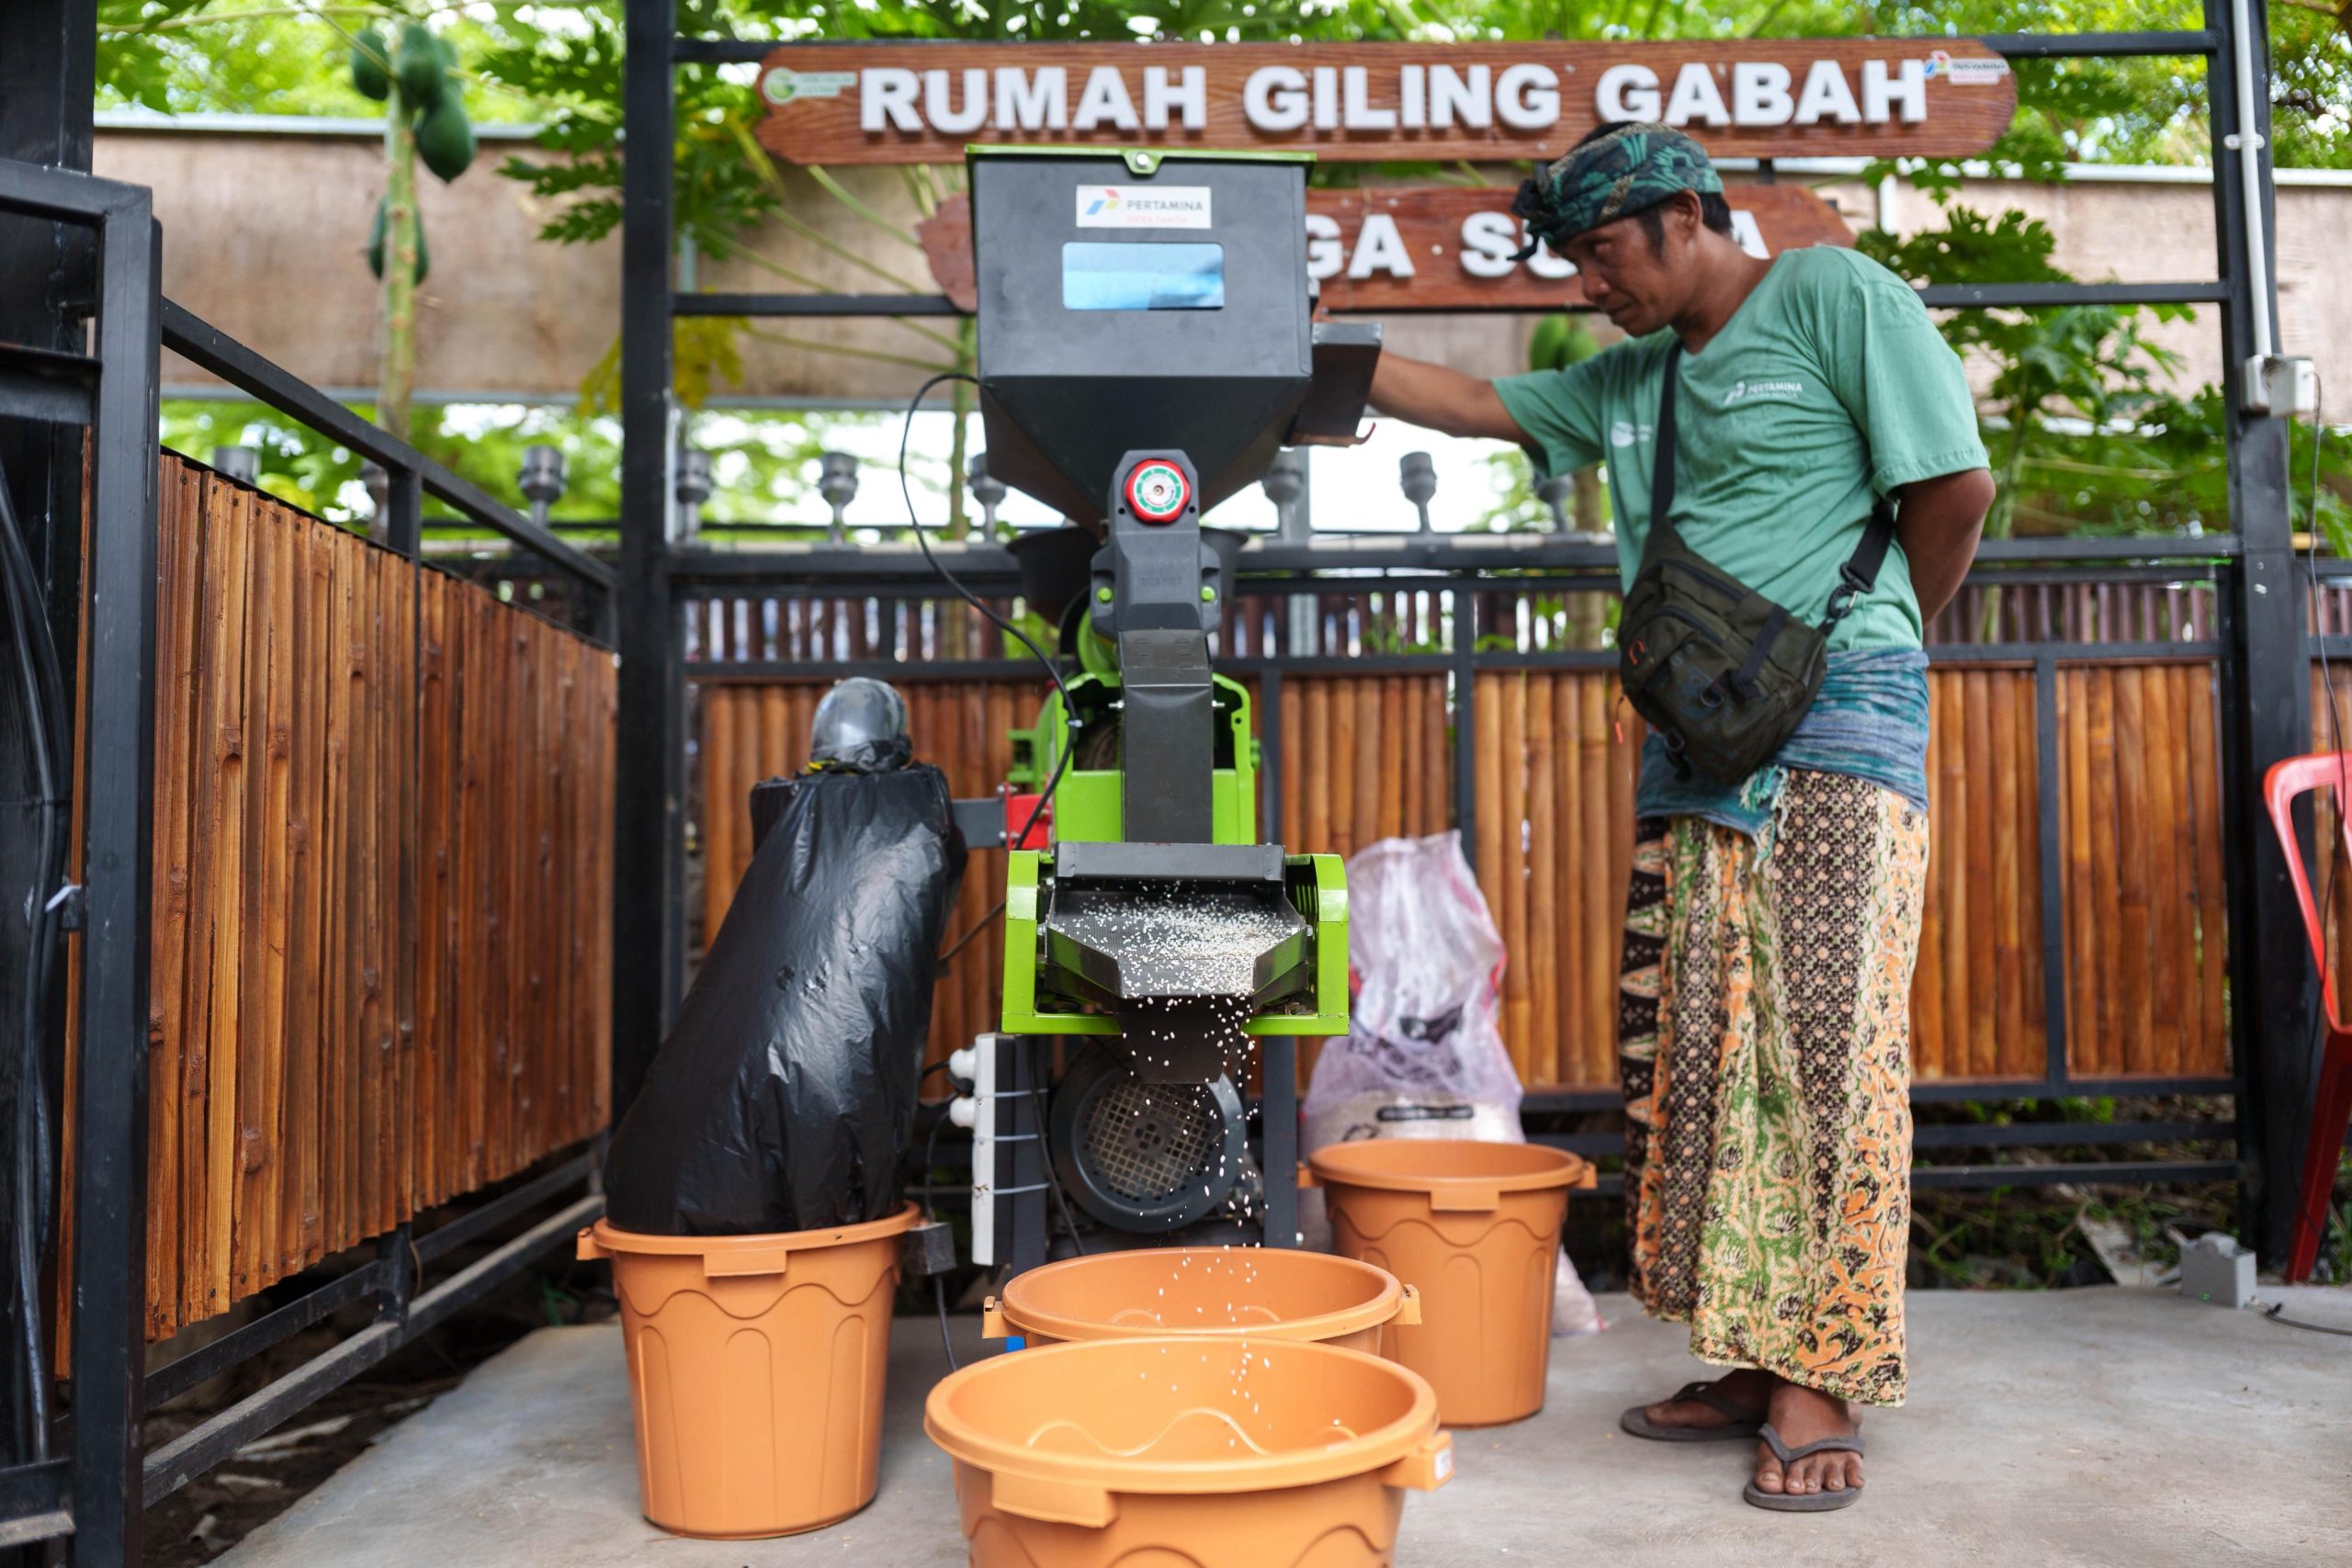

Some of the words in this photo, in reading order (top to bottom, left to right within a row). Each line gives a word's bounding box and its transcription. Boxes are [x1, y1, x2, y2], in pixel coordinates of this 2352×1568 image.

[860, 66, 1206, 133] RUMAH
[1243, 63, 1561, 130] GILING
[1595, 60, 1928, 126] GABAH
[1126, 199, 1204, 211] PERTAMINA
